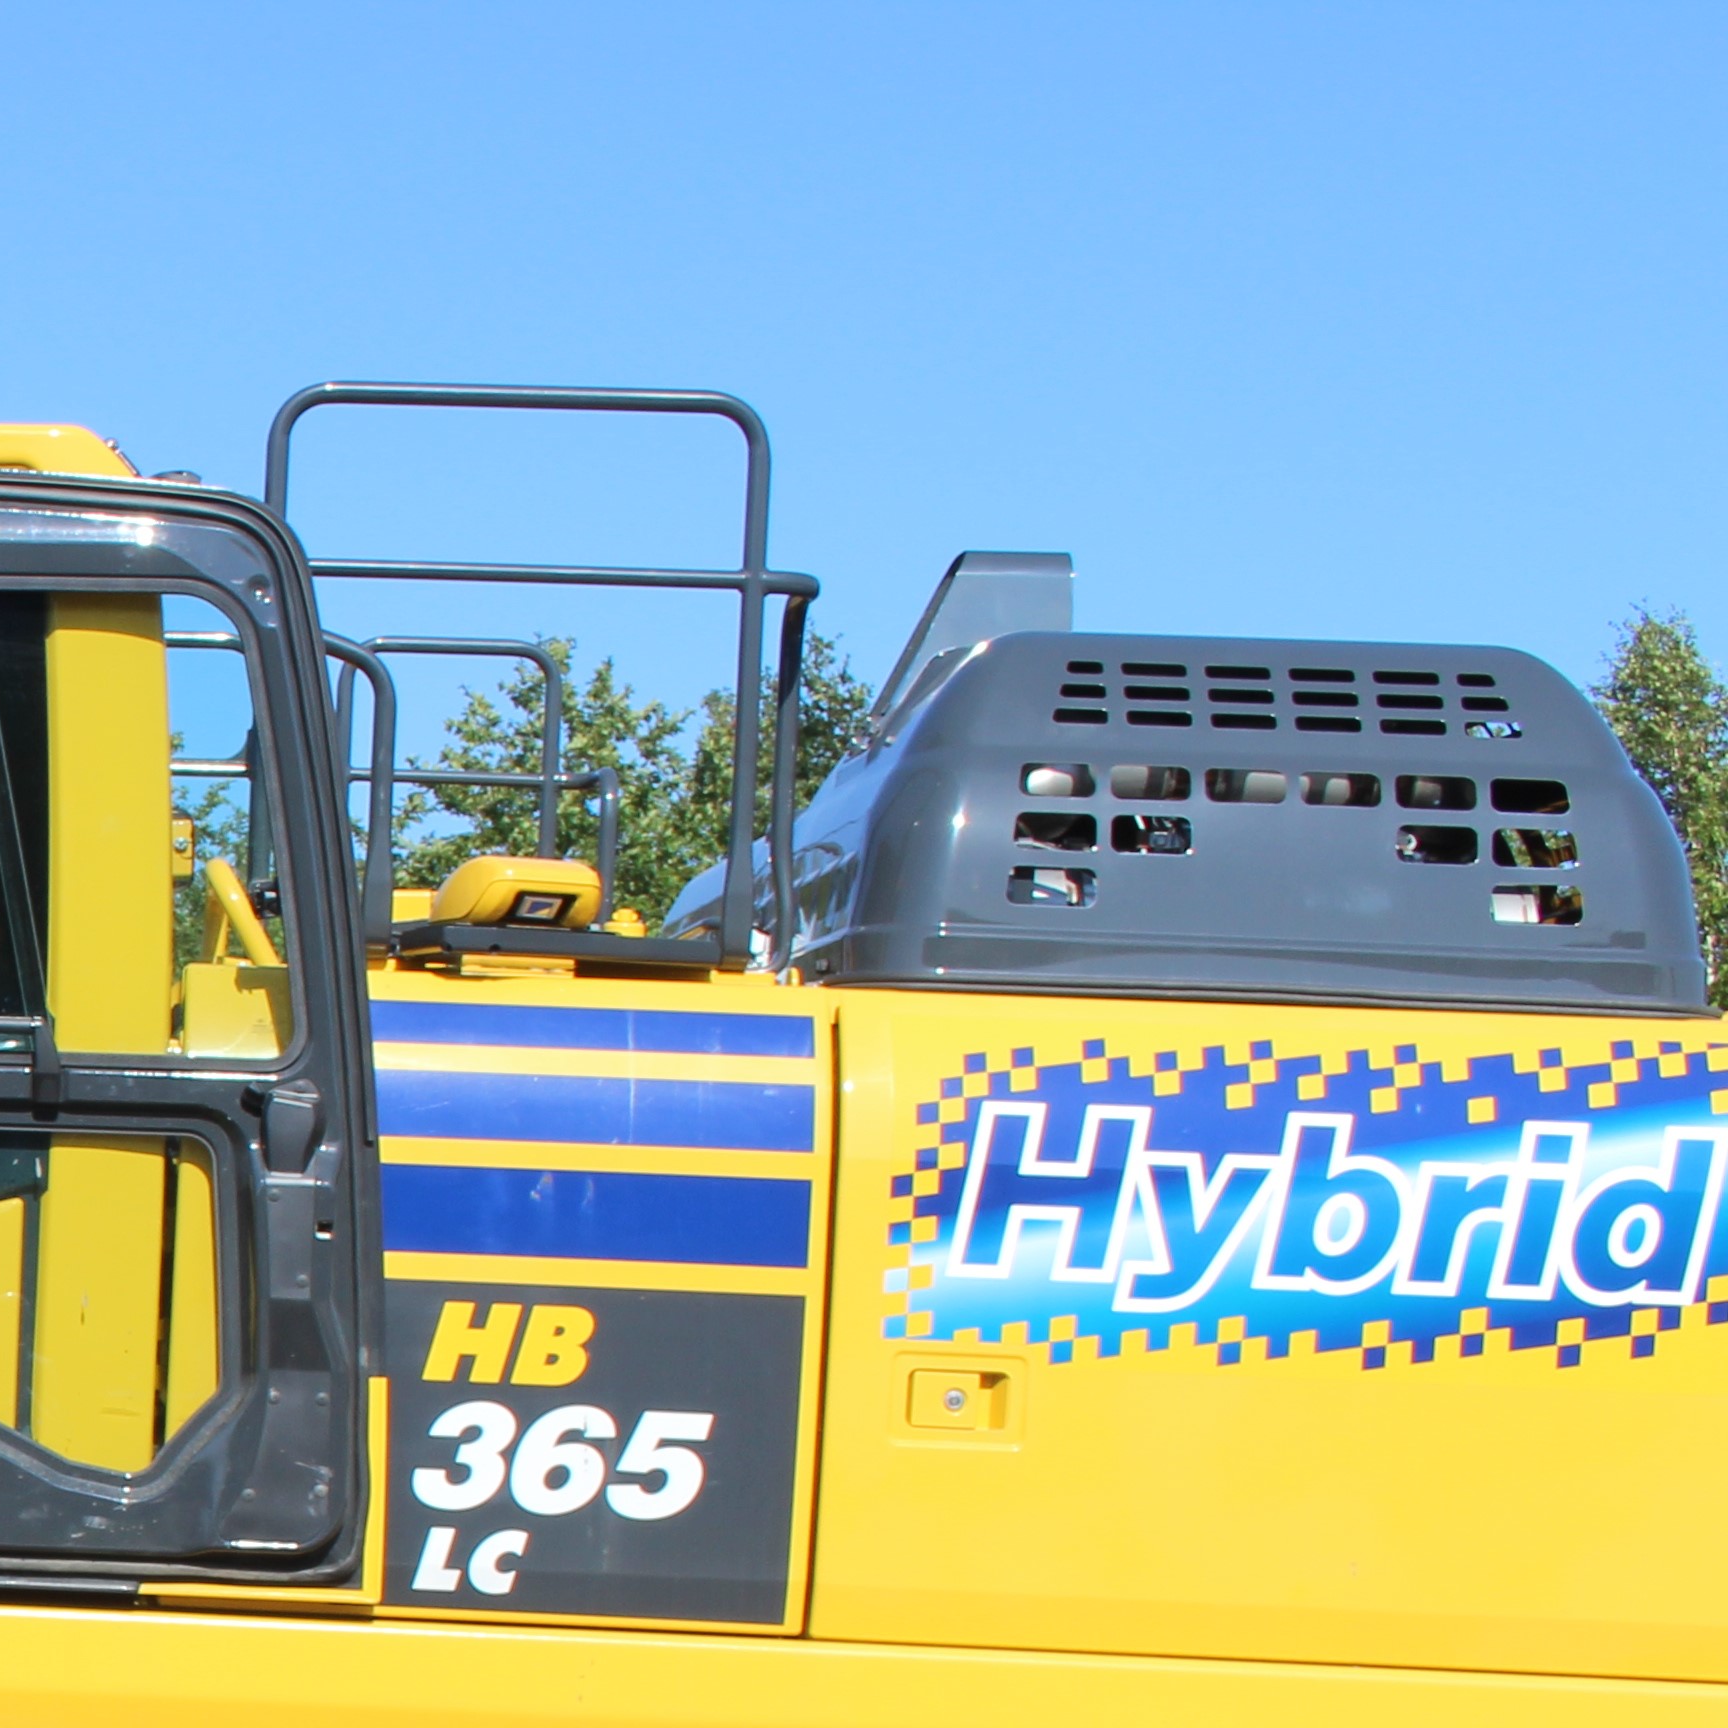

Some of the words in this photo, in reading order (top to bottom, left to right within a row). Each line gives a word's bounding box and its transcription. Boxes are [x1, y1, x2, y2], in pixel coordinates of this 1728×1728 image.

[945, 1098, 1728, 1318] Hybrid
[420, 1300, 597, 1388] HB
[410, 1400, 716, 1521] 365
[410, 1526, 530, 1596] LC
